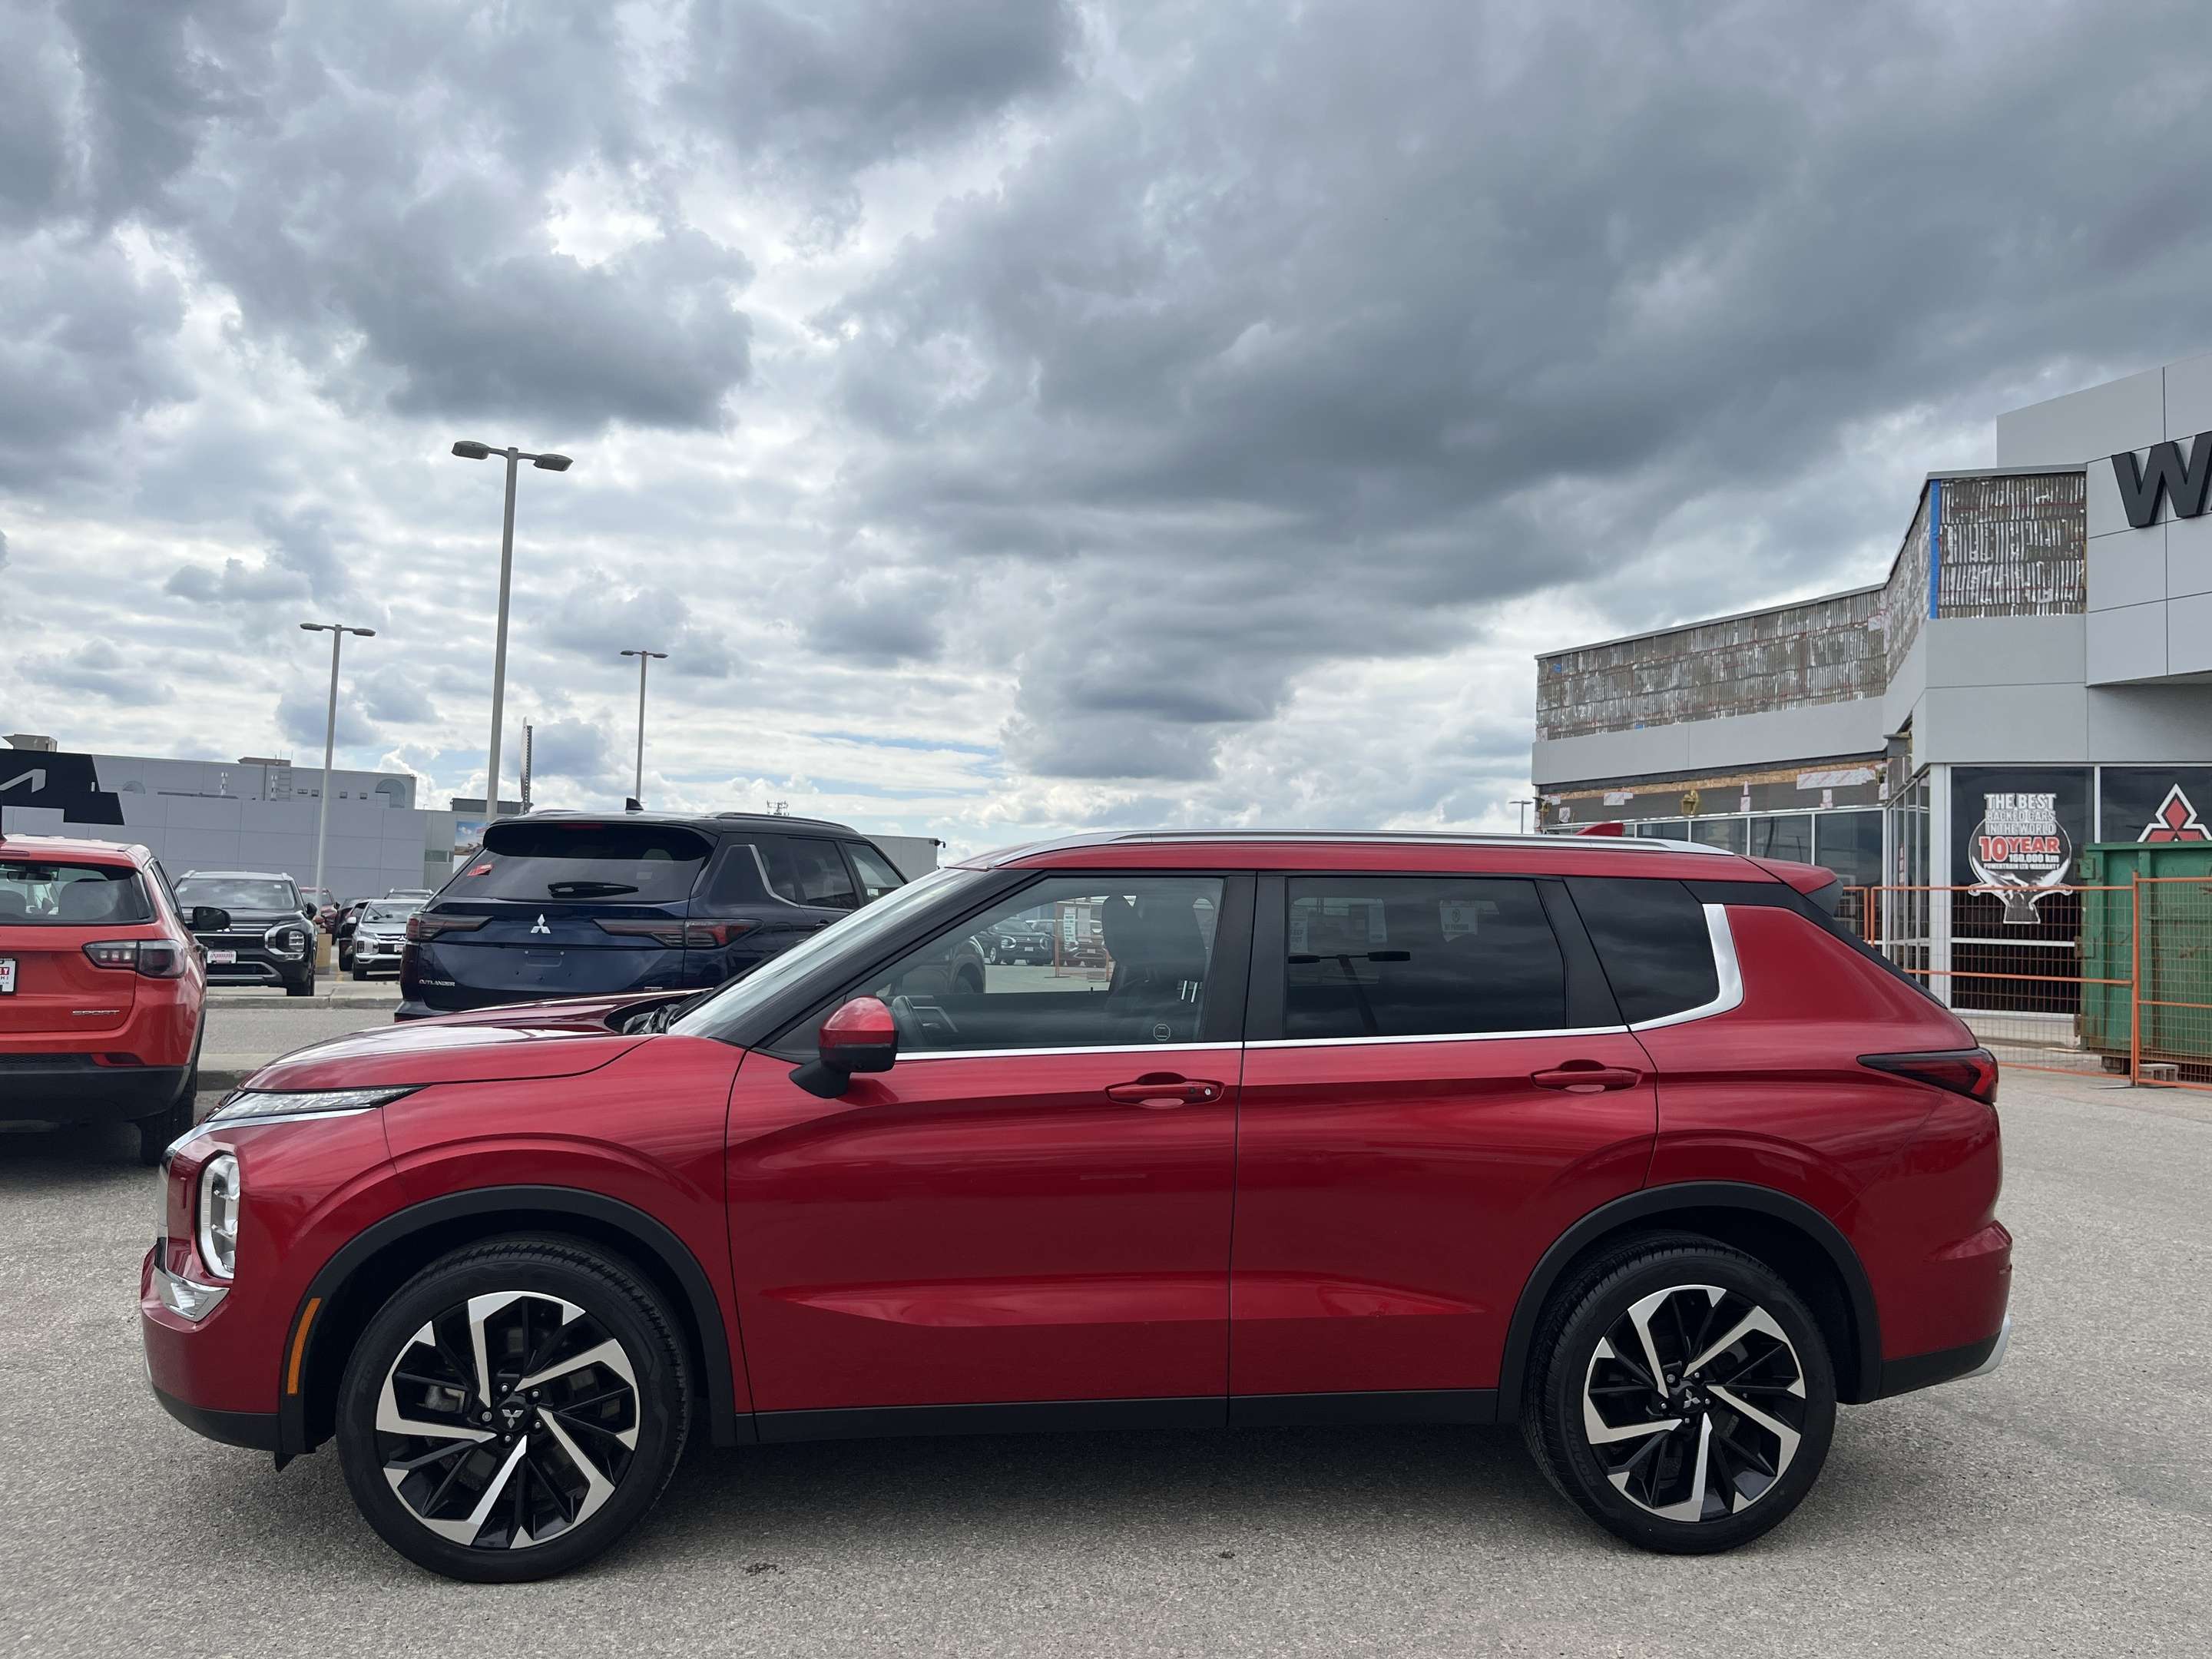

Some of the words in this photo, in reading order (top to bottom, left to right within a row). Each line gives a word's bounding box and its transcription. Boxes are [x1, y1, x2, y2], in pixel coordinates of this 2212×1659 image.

[1984, 793, 2015, 810] THE
[2017, 793, 2057, 810] BEST
[1985, 810, 2024, 822] BACKED
[2027, 810, 2055, 822] CARS
[1985, 823, 1996, 835] IN
[1997, 823, 2017, 835] THE
[2018, 823, 2057, 835] WORLD
[1979, 836, 2008, 862] 10
[2006, 836, 2061, 853] YEAR
[419, 979, 455, 987] OUTLANDER
